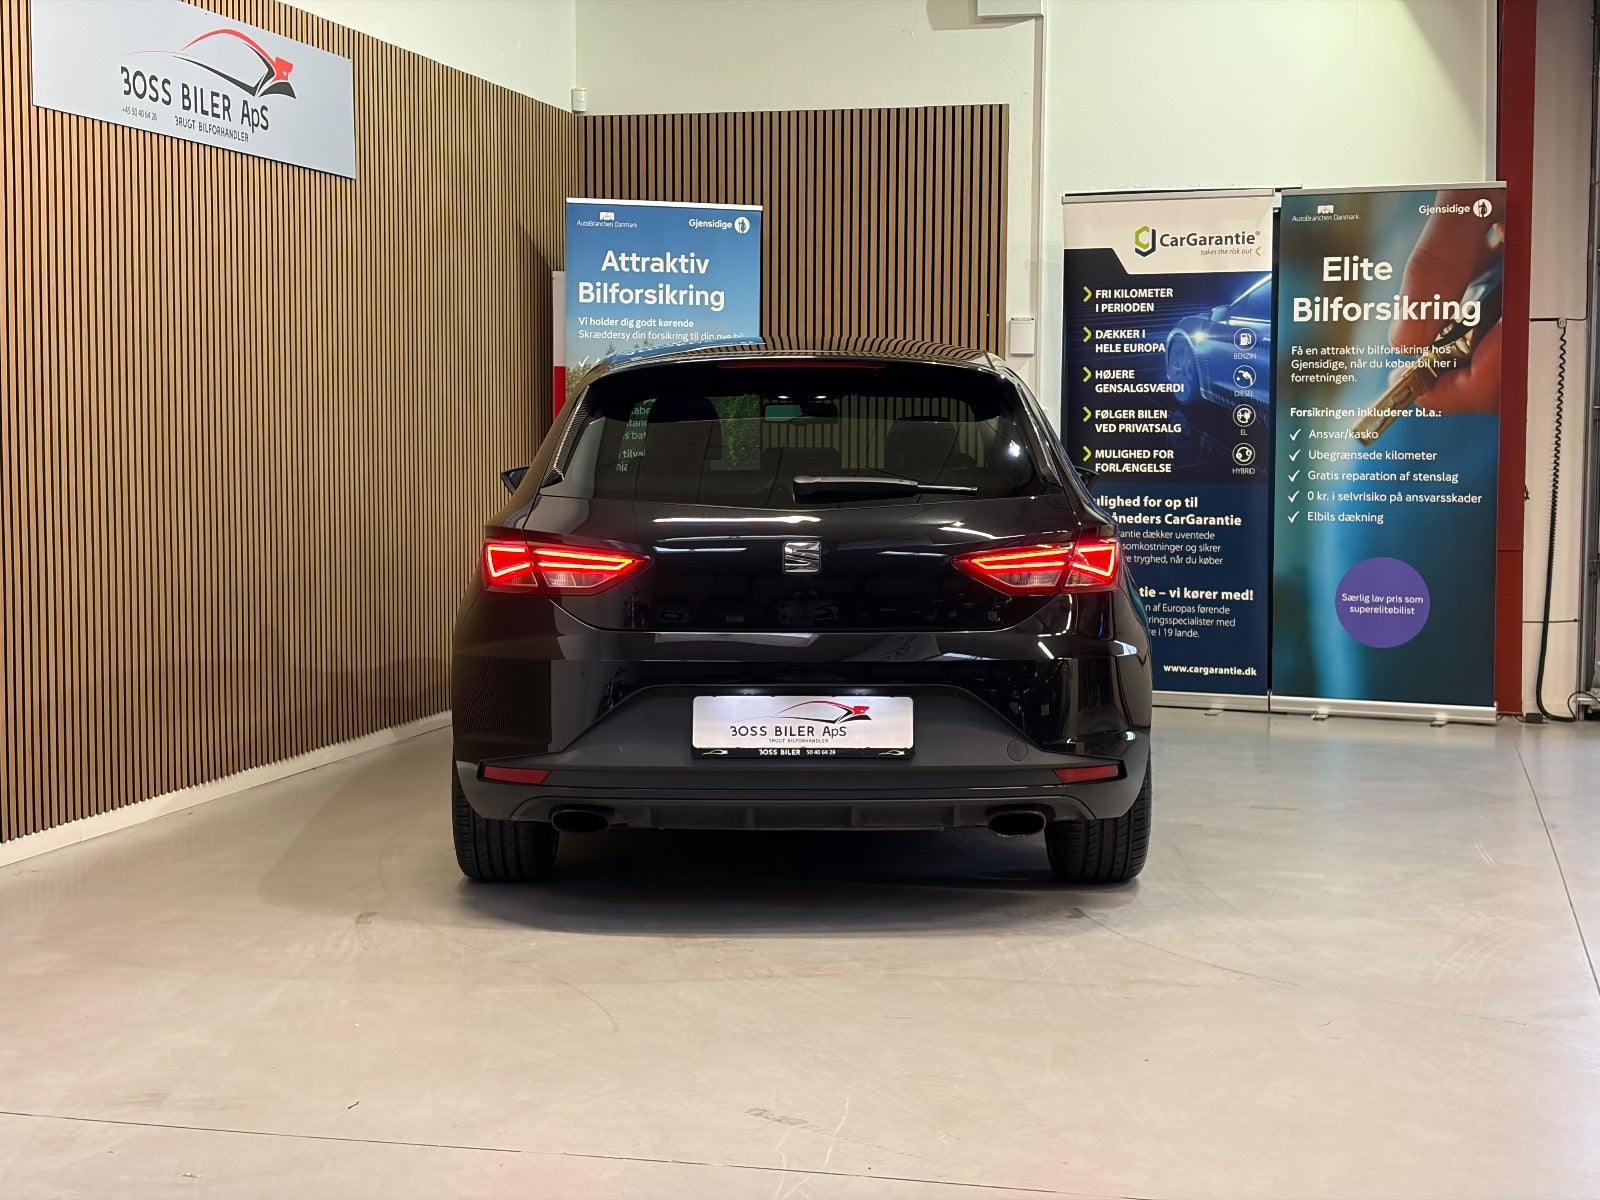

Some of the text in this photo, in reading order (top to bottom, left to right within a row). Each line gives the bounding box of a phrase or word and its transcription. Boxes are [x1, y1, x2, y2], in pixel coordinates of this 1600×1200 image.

[182, 82, 232, 122] BILER
[241, 100, 269, 133] ApS
[1418, 204, 1470, 216] Gjensidige
[688, 218, 732, 230] Gjensidige
[601, 250, 710, 274] Attraktiv
[1323, 255, 1393, 282] Elite
[578, 282, 725, 311] Bilforsikring
[1095, 288, 1174, 299] FRI KILOMETER
[1095, 302, 1154, 312] I PERIODEN
[1293, 294, 1481, 326] Bilforsikring
[579, 317, 694, 328] Vi holder dig godt kørende
[579, 330, 630, 341] Skræddersy
[632, 330, 646, 340] din
[648, 331, 688, 342] forsikring
[1095, 329, 1146, 339] DÆKKER I
[1095, 342, 1166, 352] HELE EUROPA
[1291, 344, 1451, 357] Få en attraktiv bilforsikring hos
[1291, 358, 1457, 370] Gjensidige, når du køber bil her i
[1095, 370, 1135, 380] HØJERE
[1291, 372, 1358, 384] forretningen.
[1094, 383, 1184, 393] GENSALGSVÆRDI
[1095, 409, 1168, 419] FØLGER BILEN
[1290, 408, 1442, 420] Forsikringen inkluderer bl.a.:
[1095, 424, 1182, 432] VED PRIVATSALG
[1308, 428, 1379, 440] Ansvar/kasko
[1095, 450, 1174, 459] MULIGHED FOR
[1308, 450, 1438, 462] Ubegrænsede kilometer
[1095, 463, 1172, 472] FORLÆNGELSE
[1308, 470, 1458, 485] Gratis reparation af stenslag
[1096, 496, 1198, 510] ulighed for op til
[1308, 491, 1314, 500] 0
[1317, 490, 1330, 501] kr.
[1338, 490, 1387, 502] selvrisiko
[1390, 492, 1403, 504] på
[1406, 493, 1482, 504] ansvarsskader
[1112, 512, 1242, 526] åneders CarGarantie
[1308, 512, 1384, 524] Elbils dækning
[1142, 530, 1173, 539] dækker
[1175, 531, 1216, 540] uventede
[1122, 542, 1221, 554] somkostninger og sikrer
[1134, 555, 1168, 565] tryghed,
[1170, 554, 1184, 564] når
[1186, 556, 1197, 564] du
[1198, 556, 1224, 564] køber
[1169, 587, 1180, 598] vi
[1184, 588, 1218, 600] kører
[1222, 588, 1254, 600] med!
[1342, 593, 1424, 604] Særlig lav pris som
[1152, 603, 1162, 612] af
[1162, 604, 1196, 614] Europas
[1197, 604, 1230, 614] førende
[1148, 616, 1236, 628] ringsspecialister med
[1163, 628, 1173, 636] 19
[1174, 629, 1200, 638] lande.
[1163, 664, 1257, 676] www.cargarantie.dk
[774, 726, 815, 736] BILER
[822, 726, 847, 738] ApS
